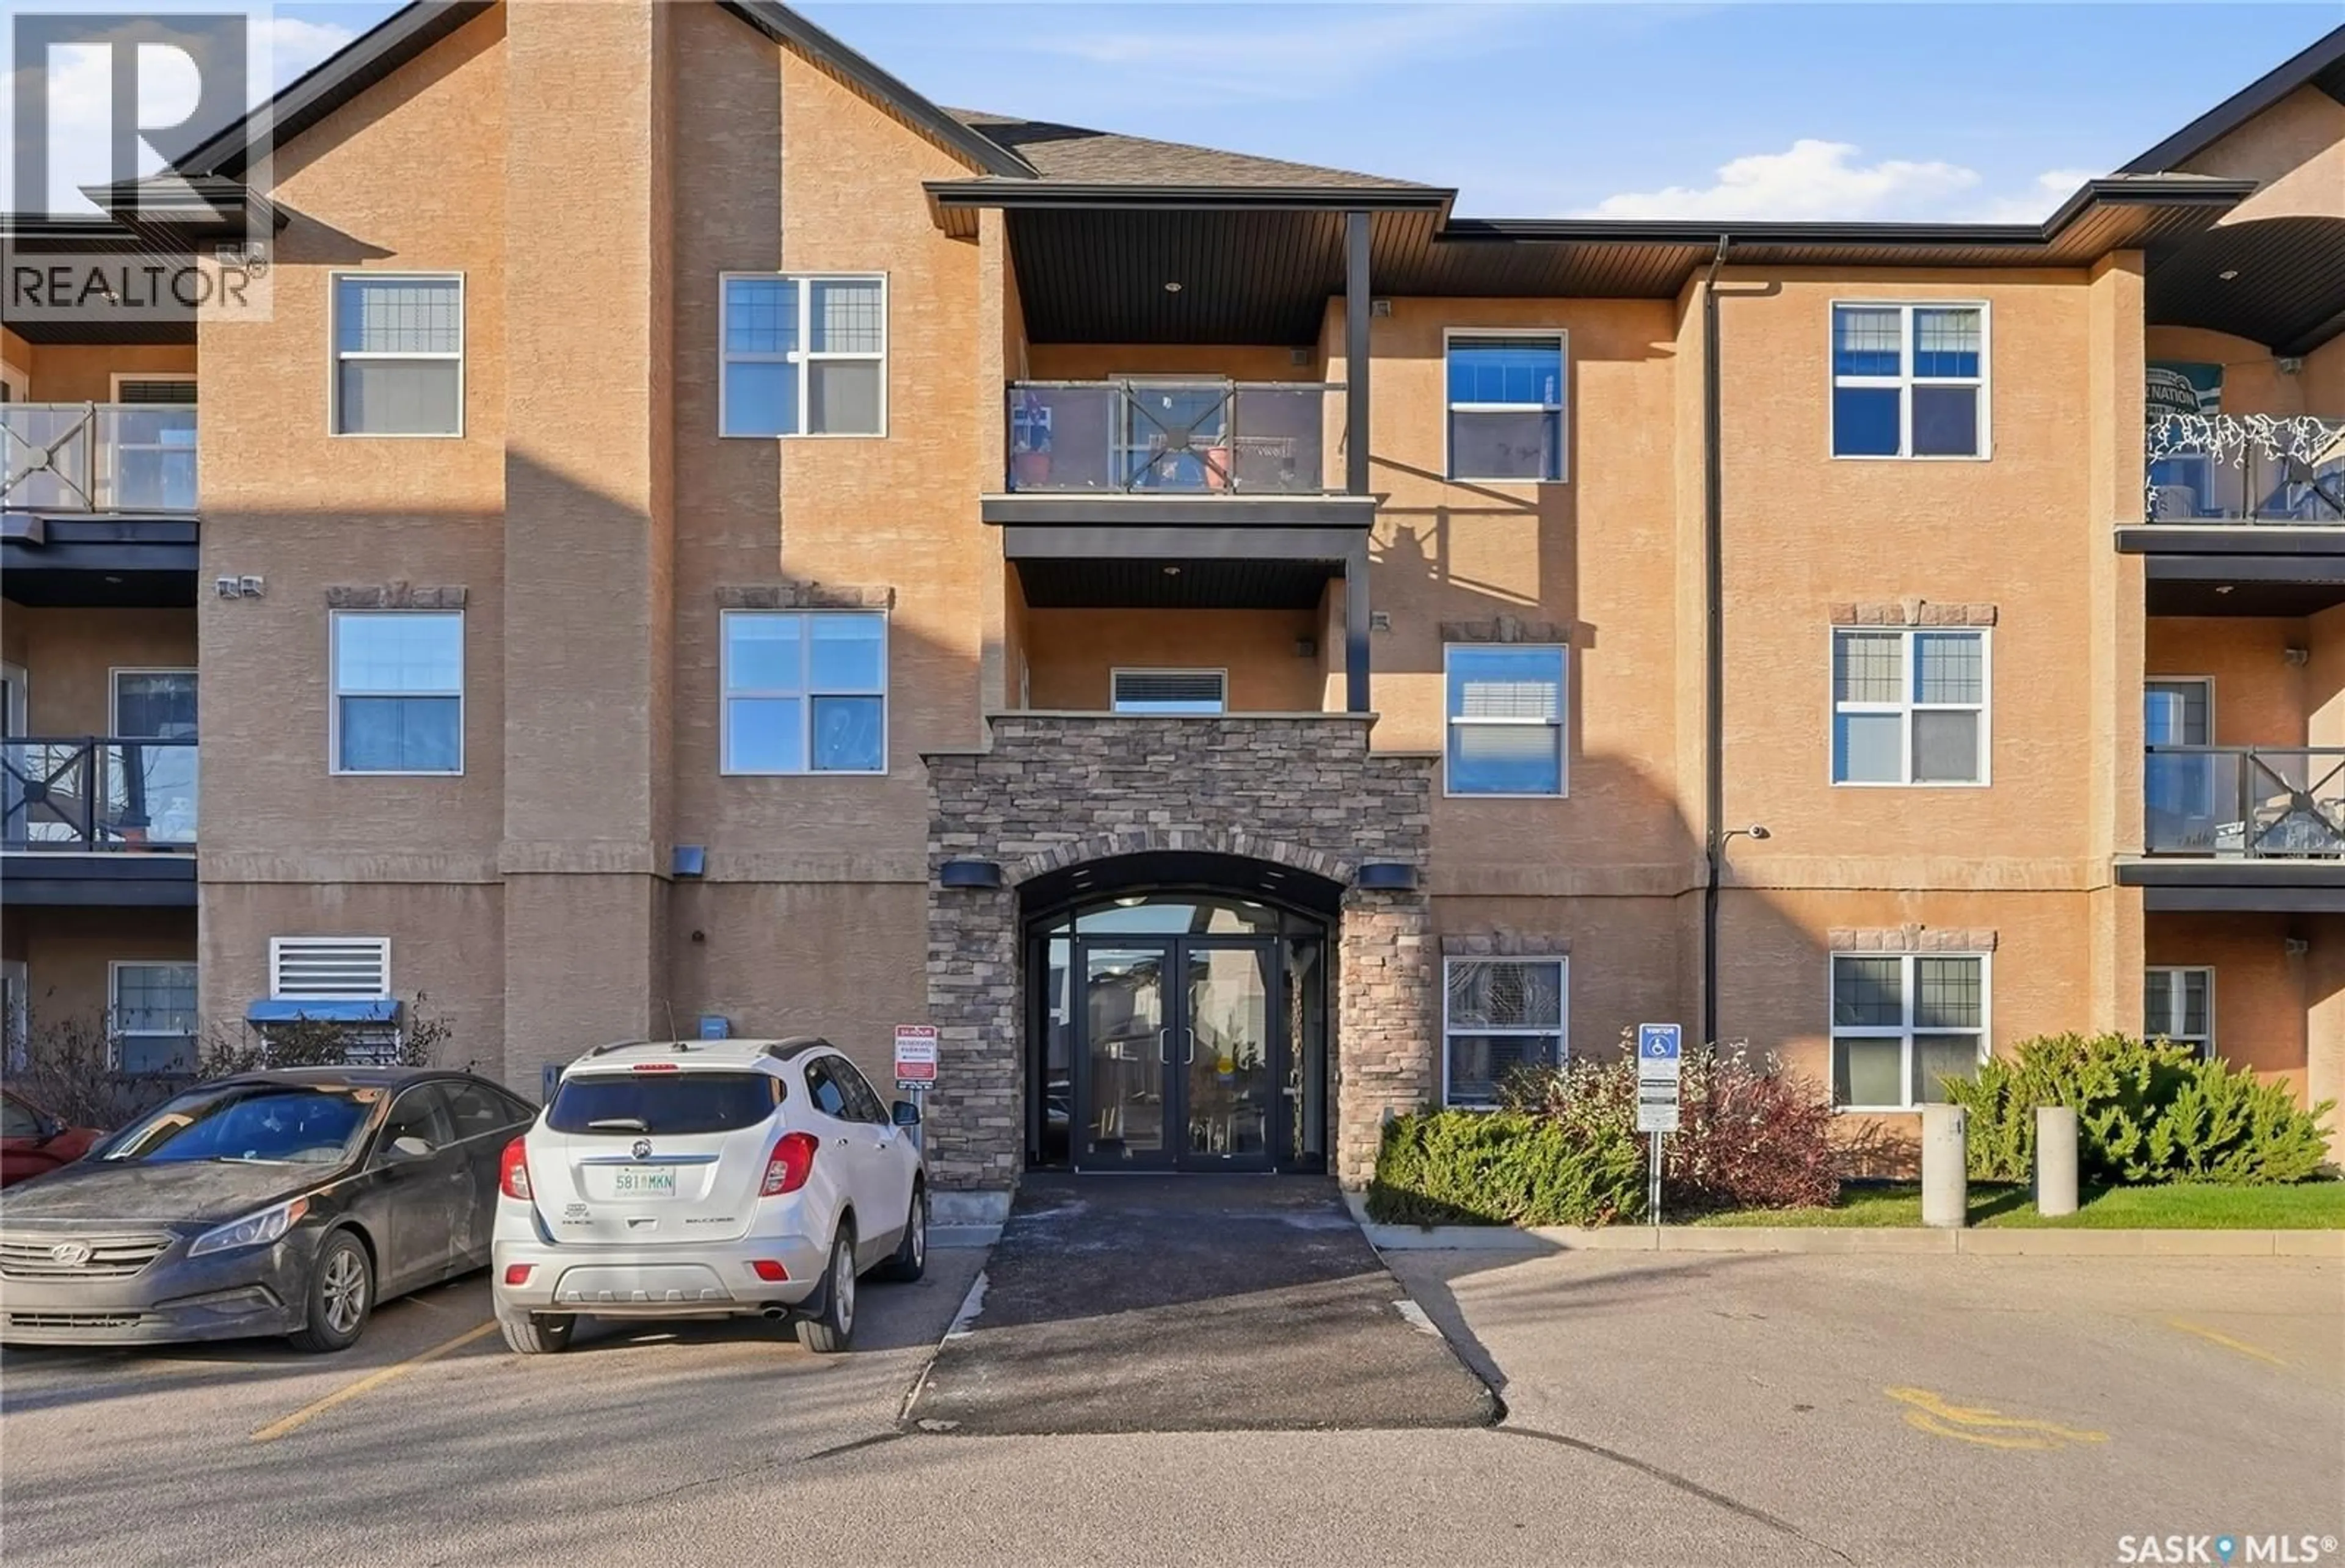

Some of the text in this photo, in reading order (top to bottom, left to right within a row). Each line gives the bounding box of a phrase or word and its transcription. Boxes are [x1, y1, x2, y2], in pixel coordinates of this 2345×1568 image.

[2150, 385, 2197, 406] NATION
[616, 1174, 673, 1189] 581 MKN
